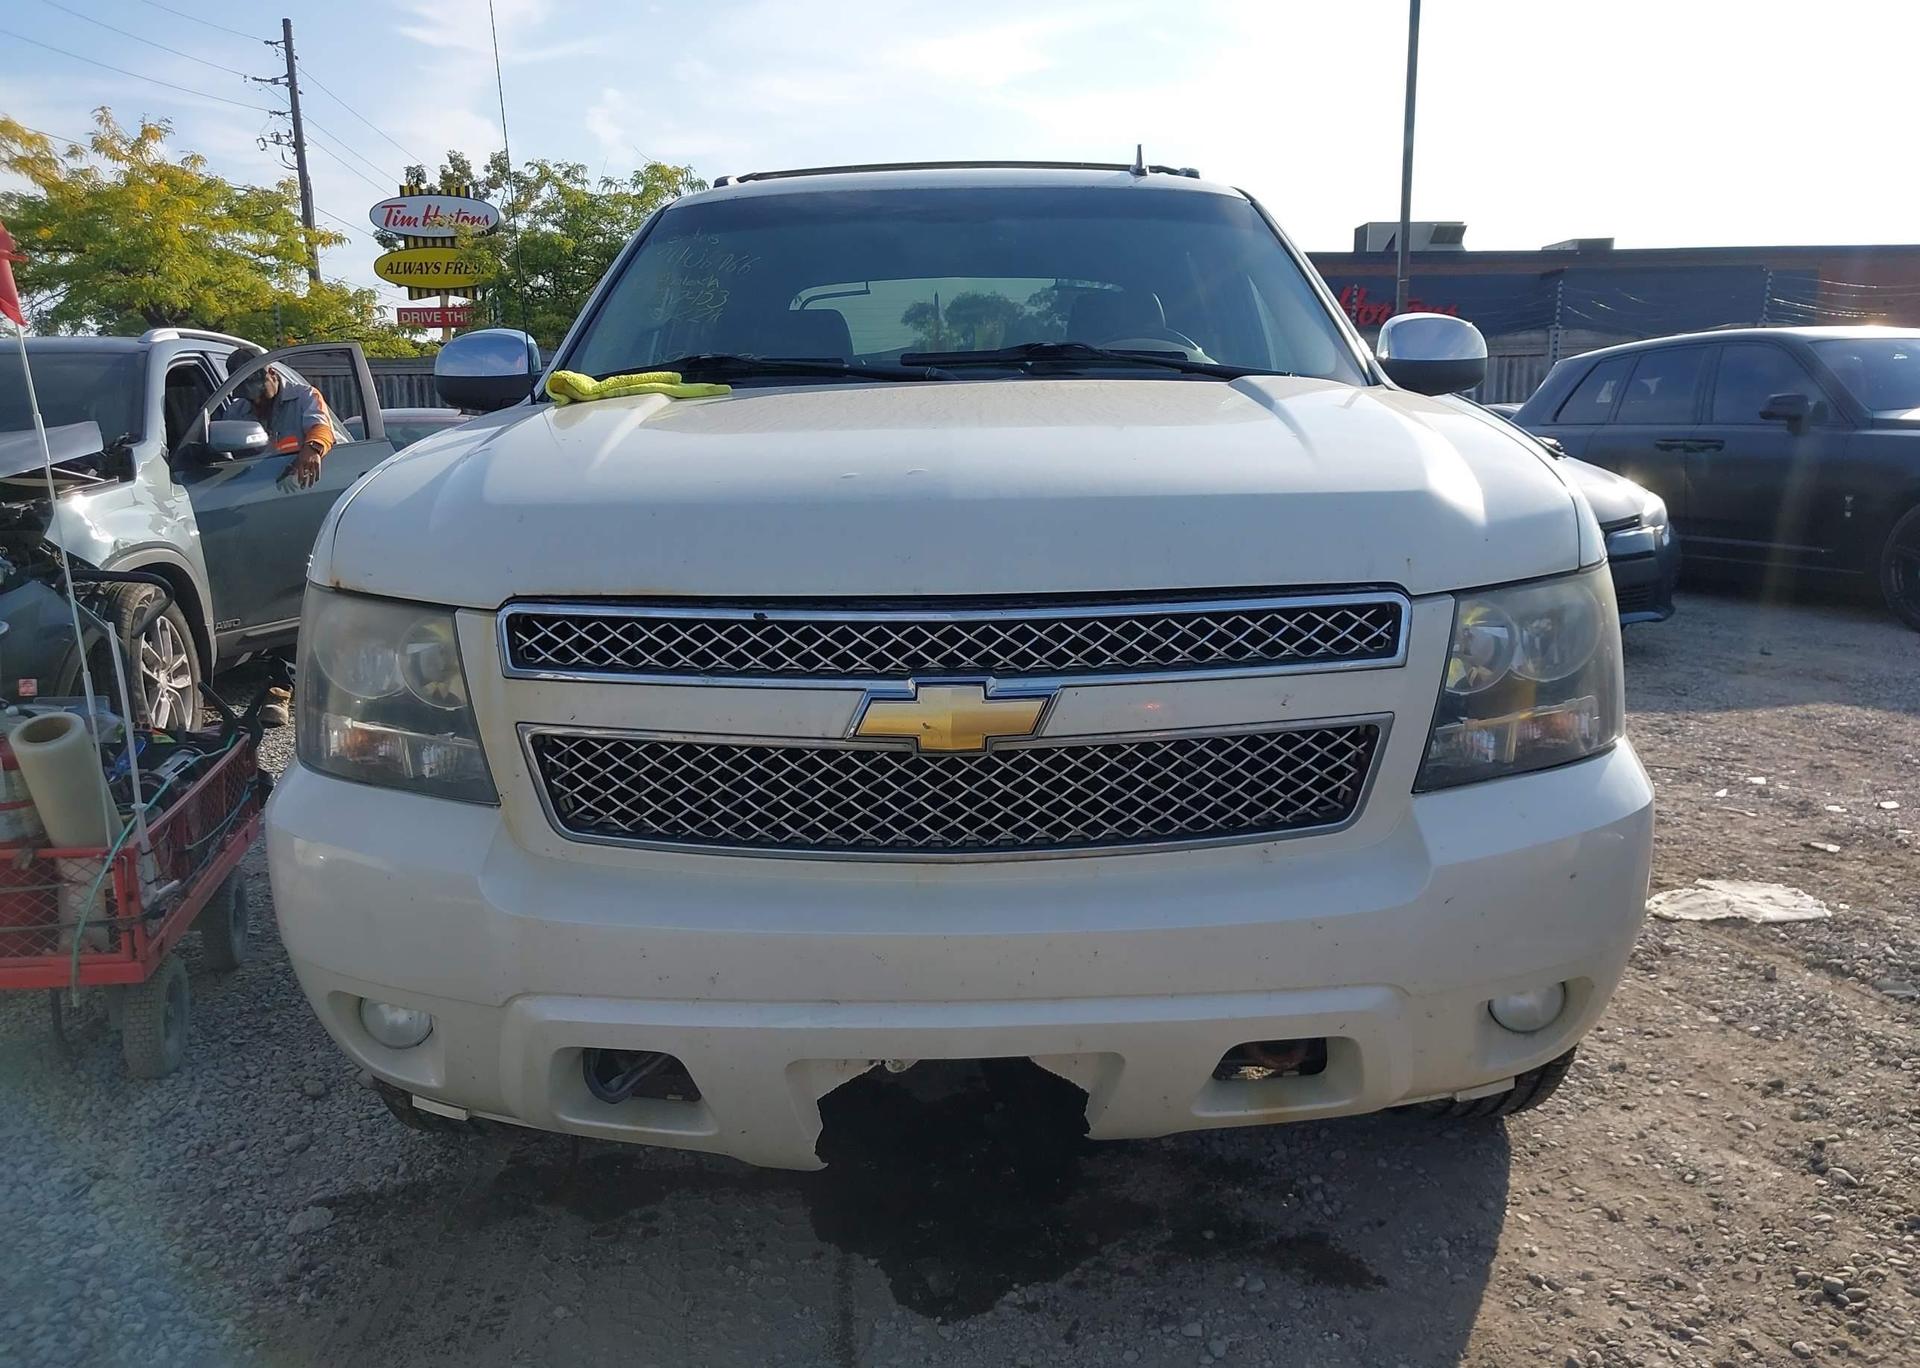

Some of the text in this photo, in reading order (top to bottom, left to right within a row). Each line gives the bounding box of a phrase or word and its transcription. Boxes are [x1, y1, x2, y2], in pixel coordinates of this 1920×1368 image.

[381, 203, 490, 228] Tim Htons
[384, 261, 489, 275] ALWAYS FRES
[401, 311, 442, 323] DRIVE
[215, 619, 240, 631] AWD
